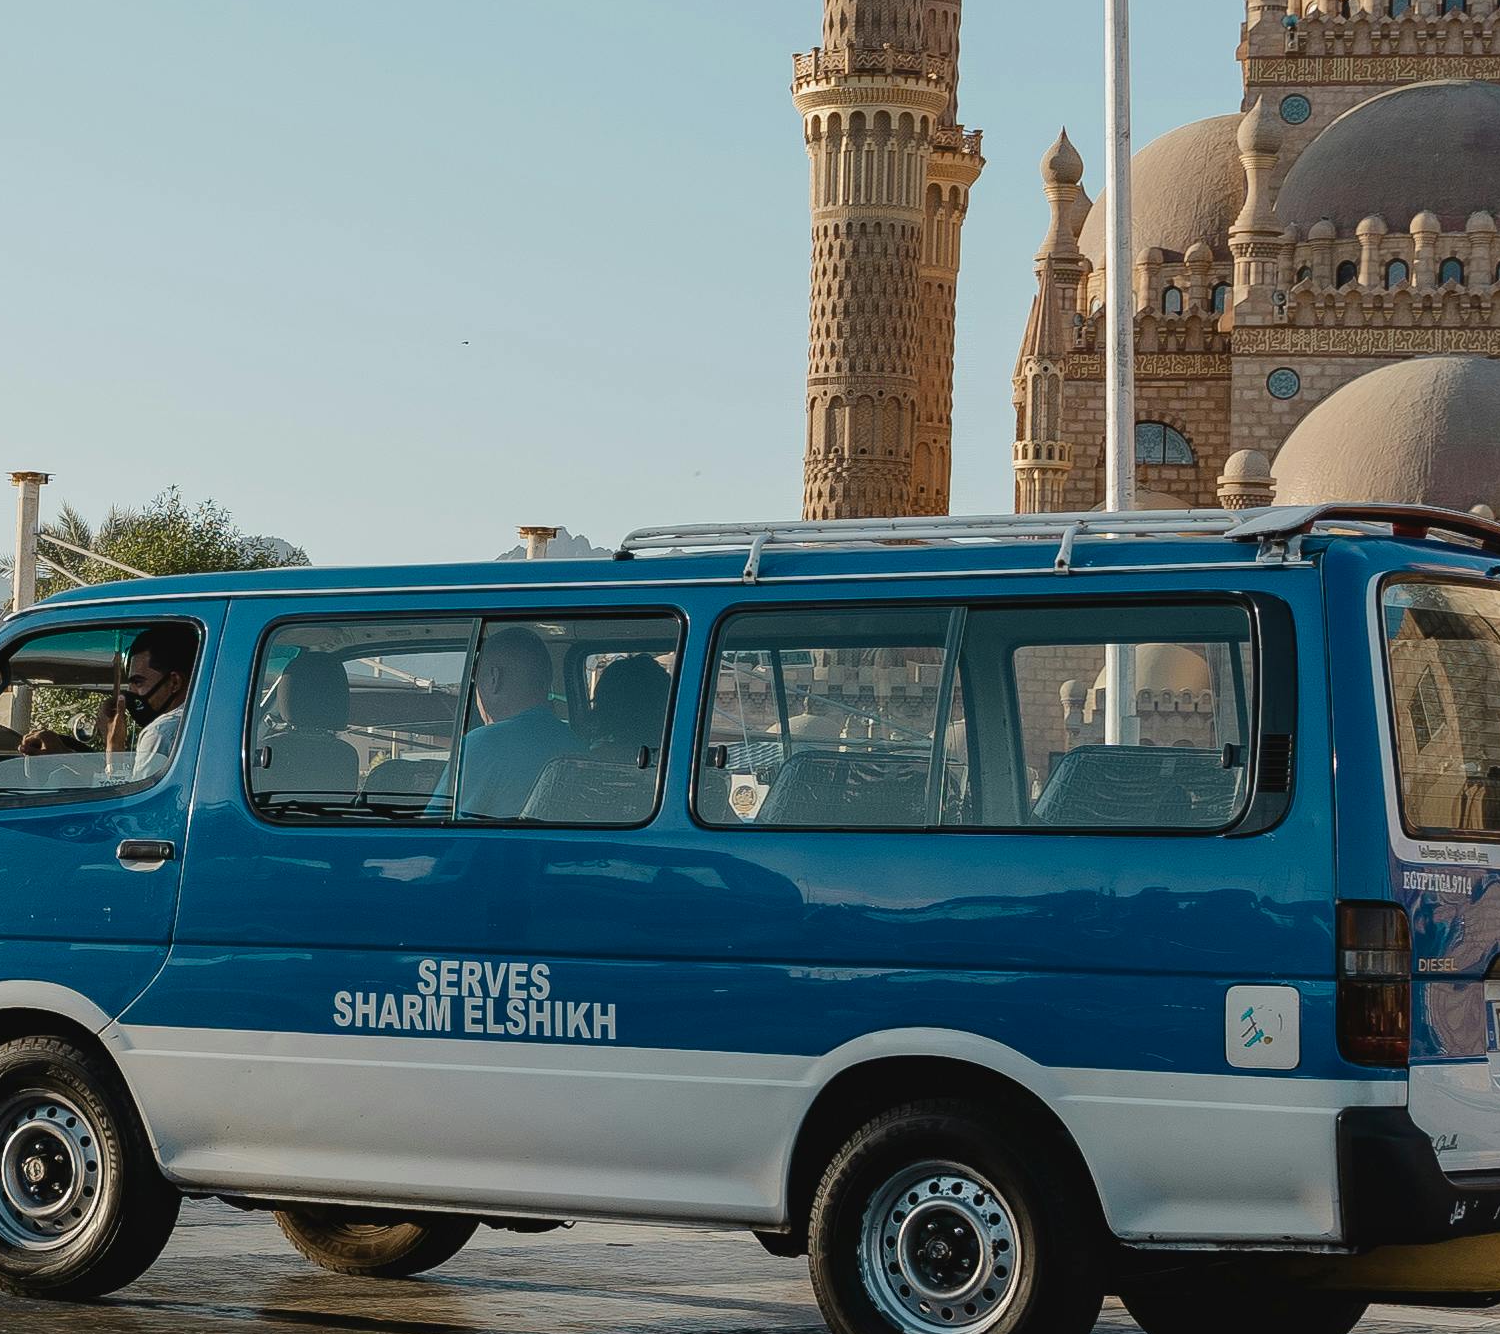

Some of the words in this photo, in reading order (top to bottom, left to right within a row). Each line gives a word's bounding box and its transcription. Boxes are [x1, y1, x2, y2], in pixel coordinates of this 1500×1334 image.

[416, 958, 552, 1001] SERVES
[1418, 958, 1458, 972] DIESEL
[332, 990, 452, 1033] SHARM
[463, 996, 618, 1041] ELSHIKH
